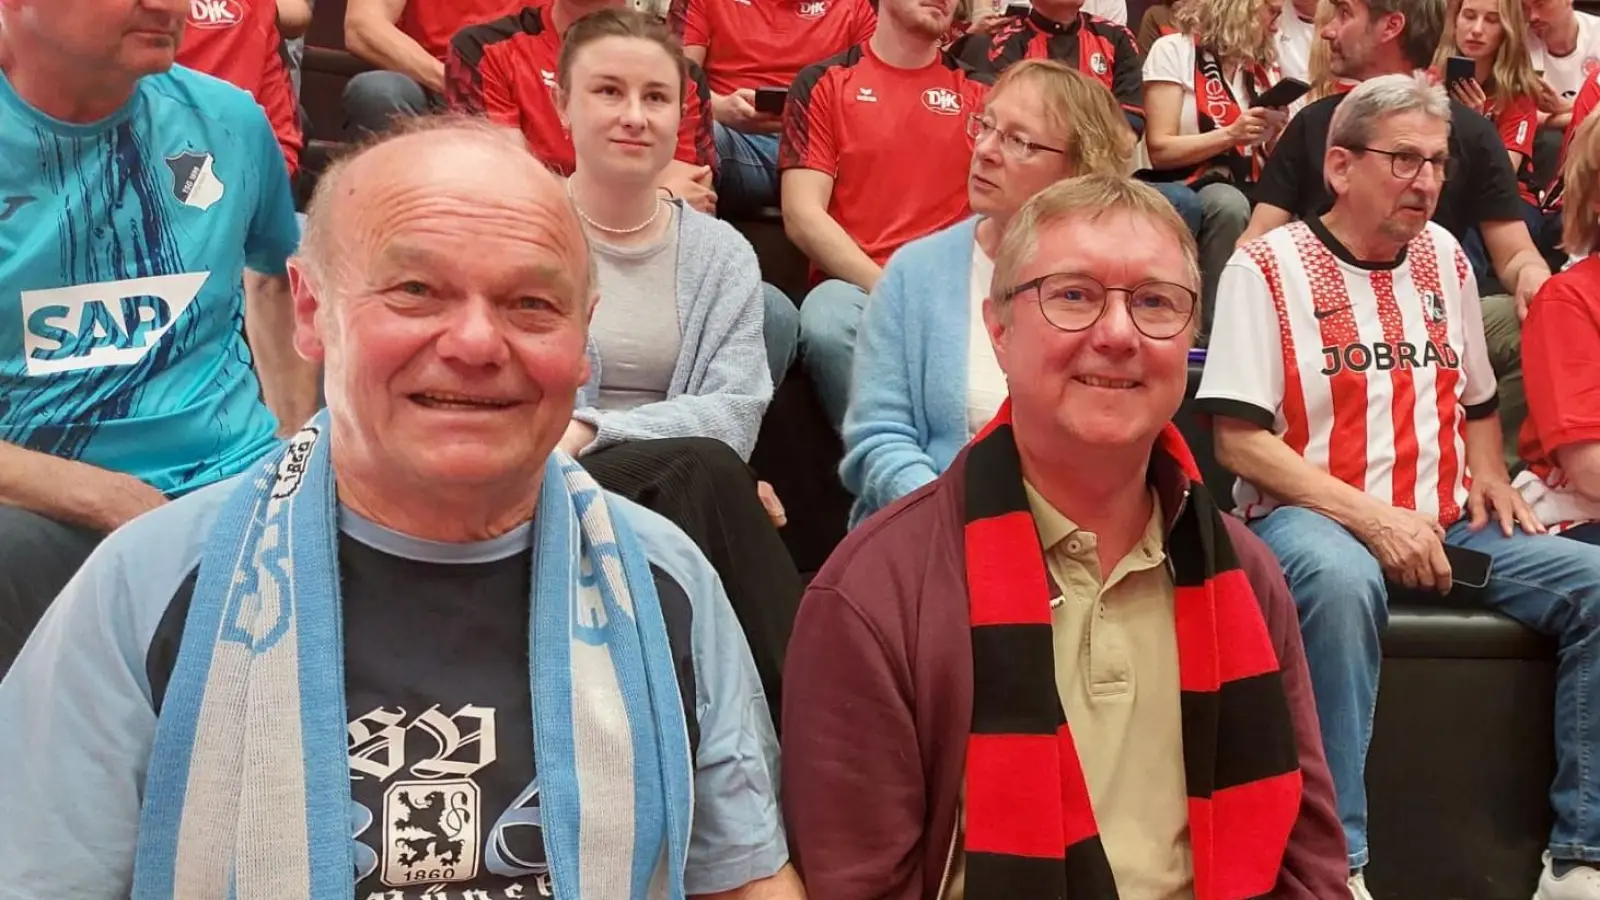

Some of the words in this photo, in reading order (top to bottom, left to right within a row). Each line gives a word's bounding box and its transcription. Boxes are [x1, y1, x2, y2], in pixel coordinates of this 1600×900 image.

[27, 294, 172, 361] SAP
[1320, 340, 1459, 376] JOBRAD
[284, 441, 310, 482] 1860
[403, 868, 455, 881] 1860
